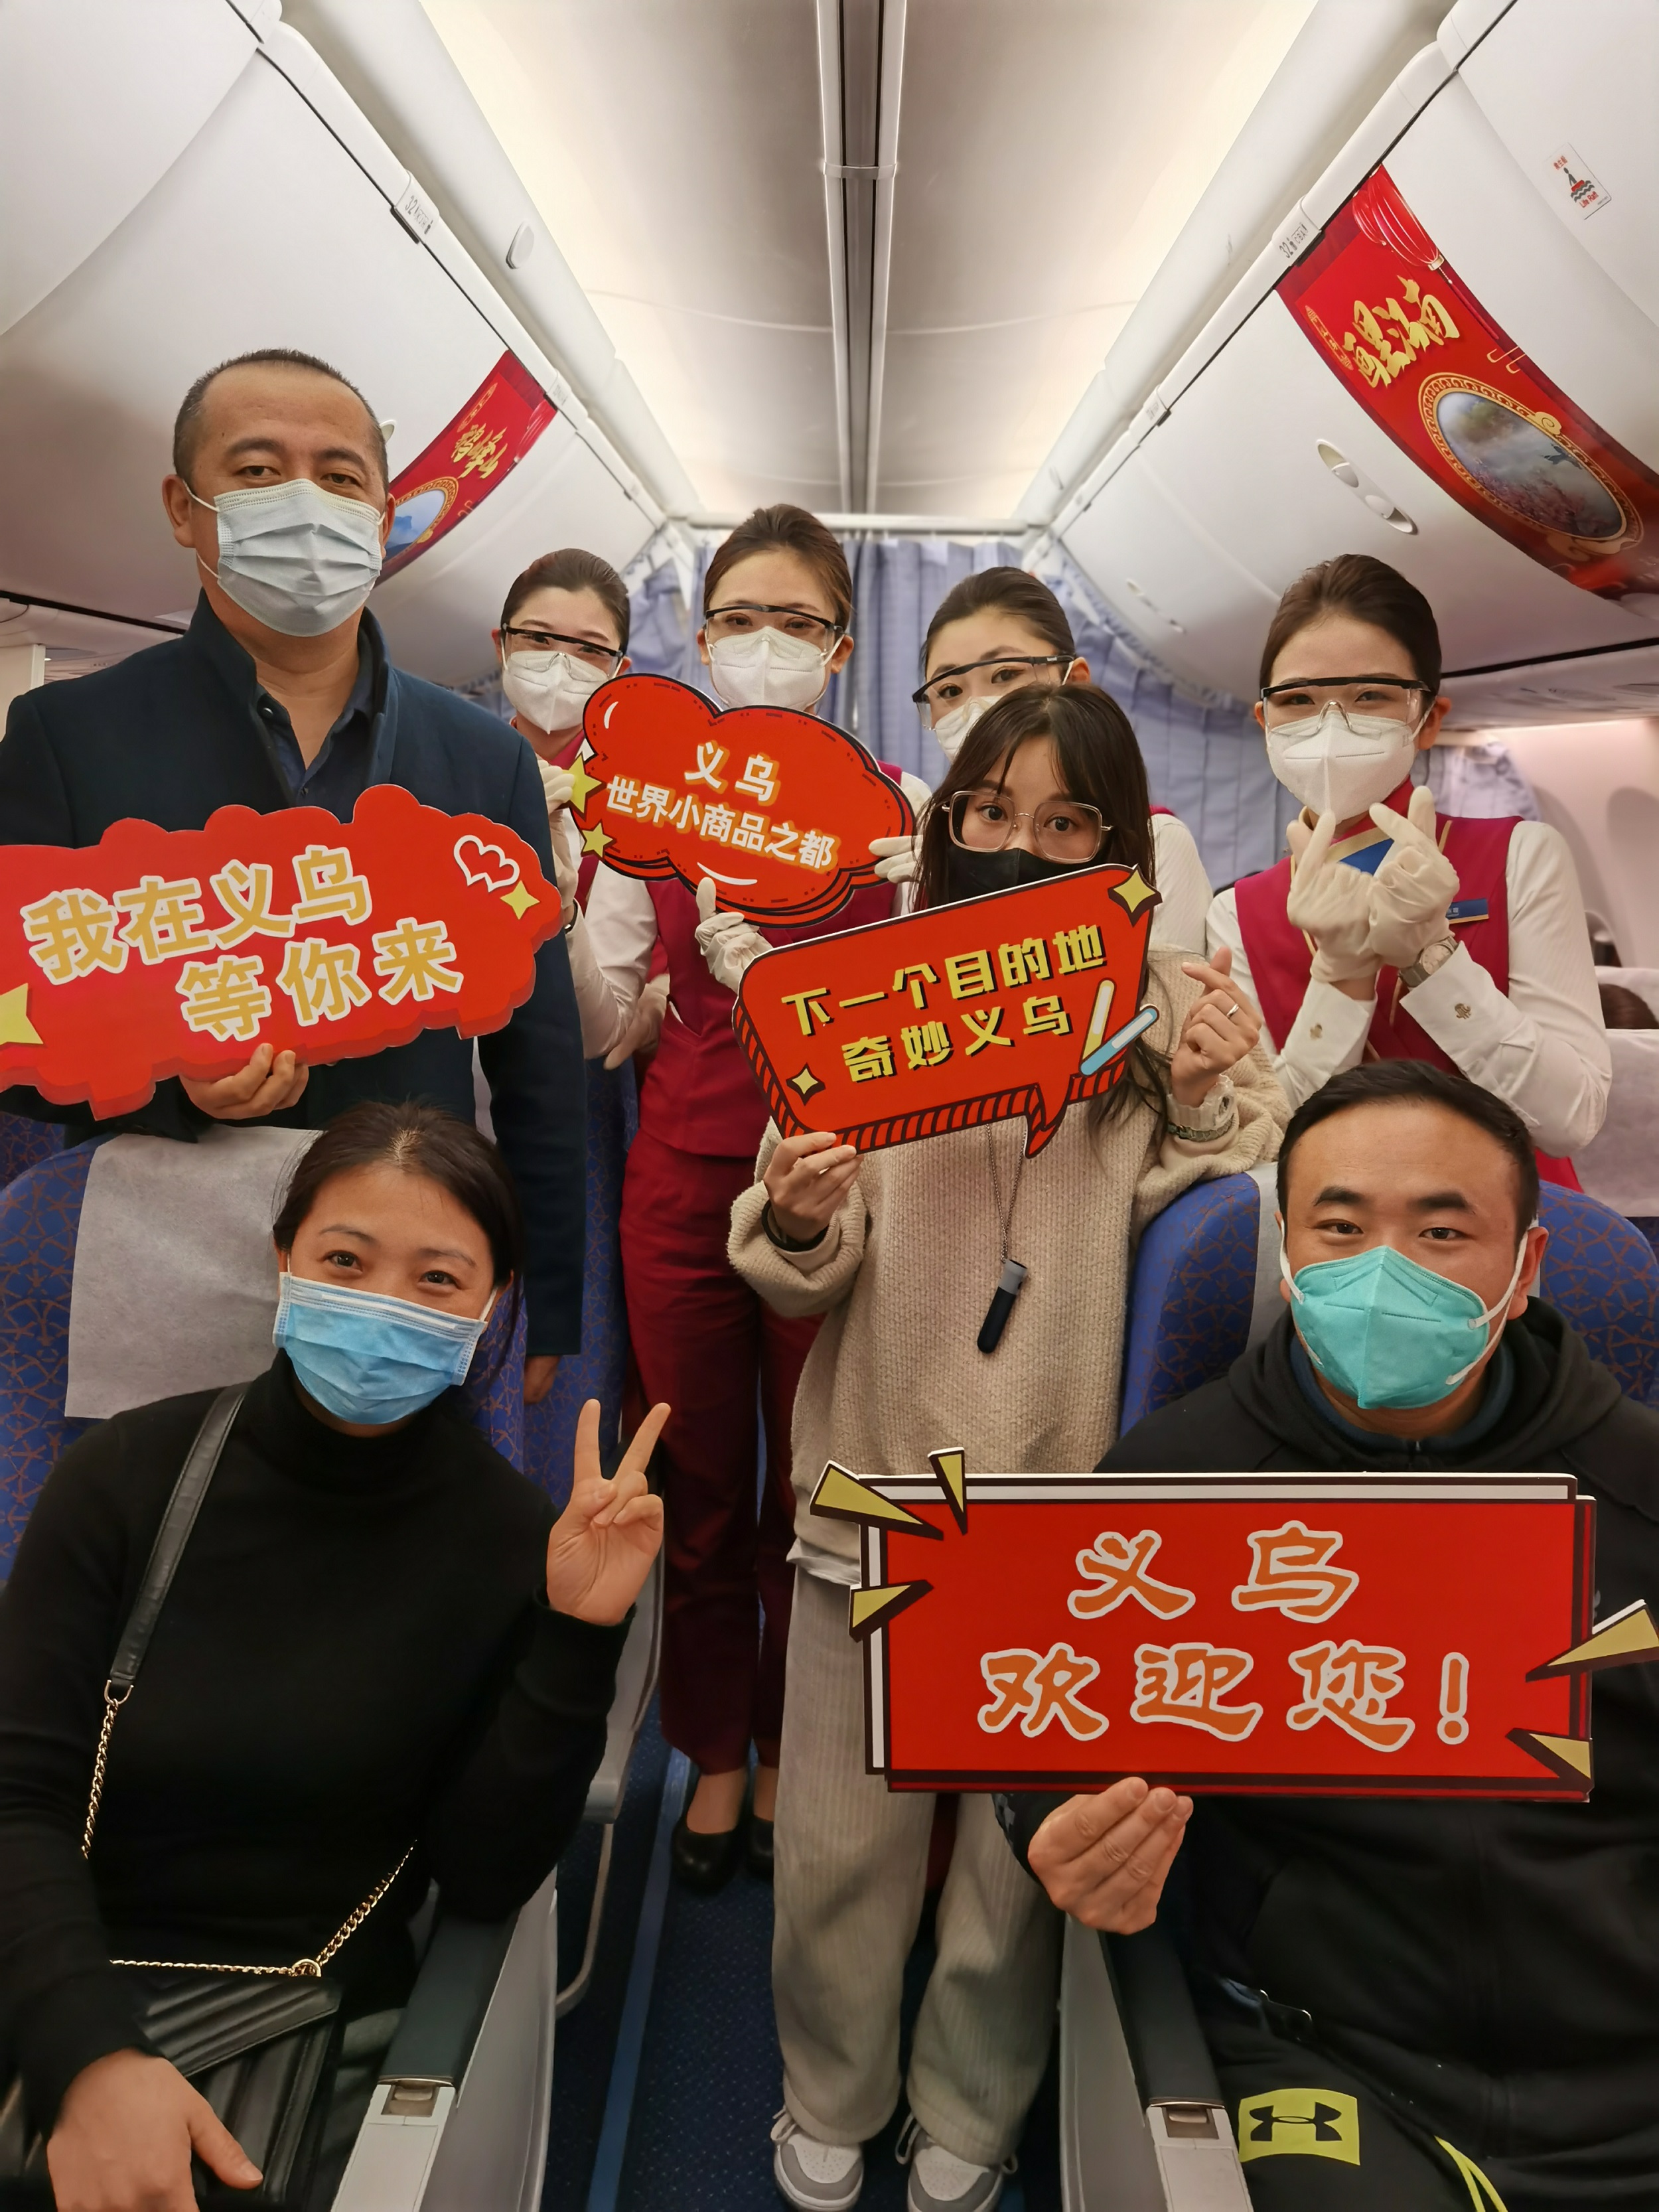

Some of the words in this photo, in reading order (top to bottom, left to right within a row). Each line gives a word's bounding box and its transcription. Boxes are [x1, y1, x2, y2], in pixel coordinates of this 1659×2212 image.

[405, 195, 418, 215] 32
[1579, 199, 1590, 208] Life
[1587, 191, 1599, 202] Raft
[1279, 242, 1294, 259] 32
[684, 740, 780, 806] 义乌
[606, 774, 841, 875] 世界小商品之都
[21, 844, 372, 985] 我在义乌
[175, 917, 464, 1042] 等你来
[782, 924, 1108, 1037] 下一个目的地
[841, 995, 1071, 1084] 奇妙义乌
[1068, 1520, 1359, 1623] 义乌
[977, 1640, 1469, 1753] 欢迎您!
